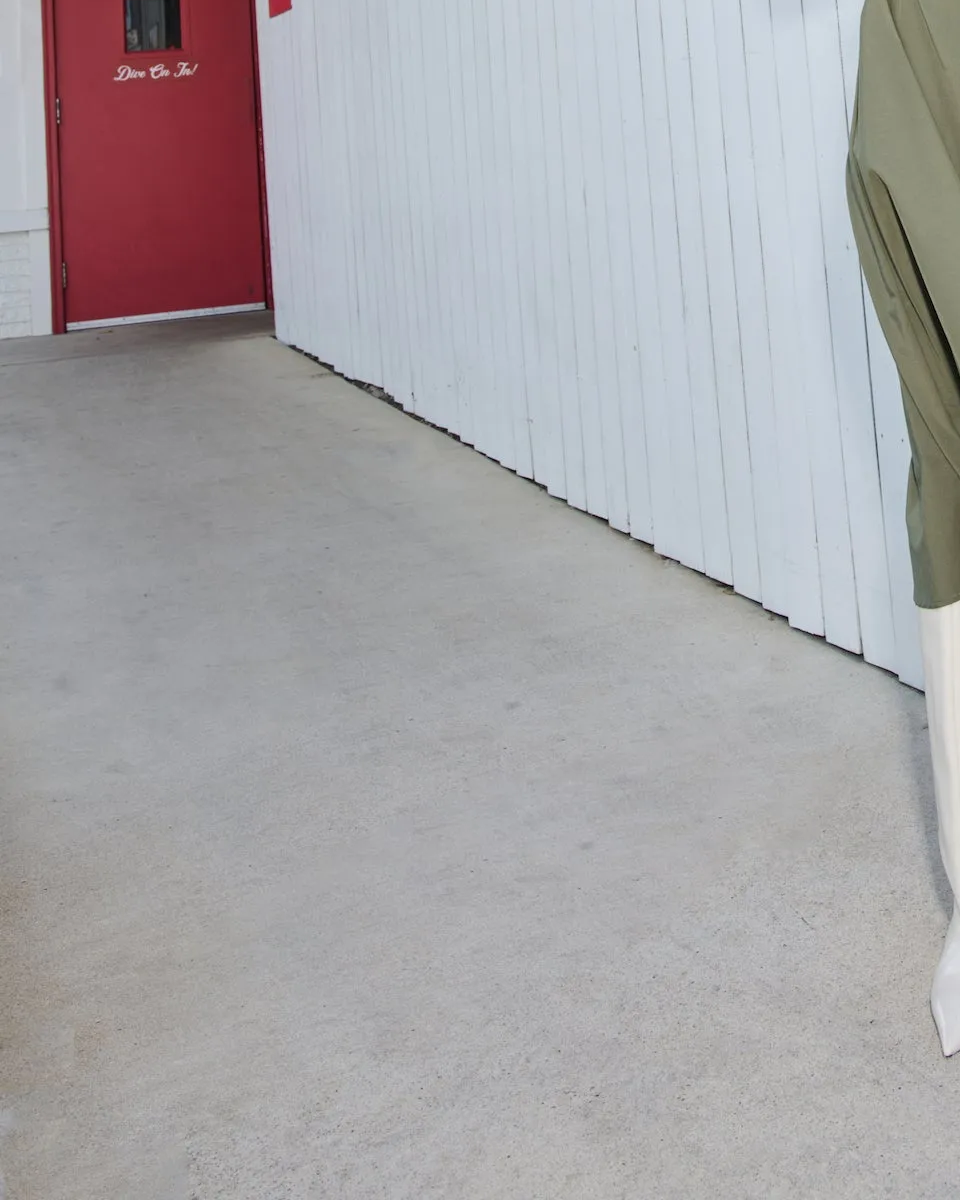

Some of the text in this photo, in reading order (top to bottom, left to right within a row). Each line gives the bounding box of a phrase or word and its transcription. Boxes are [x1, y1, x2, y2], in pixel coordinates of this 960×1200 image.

[114, 61, 199, 82] Dive On In!
